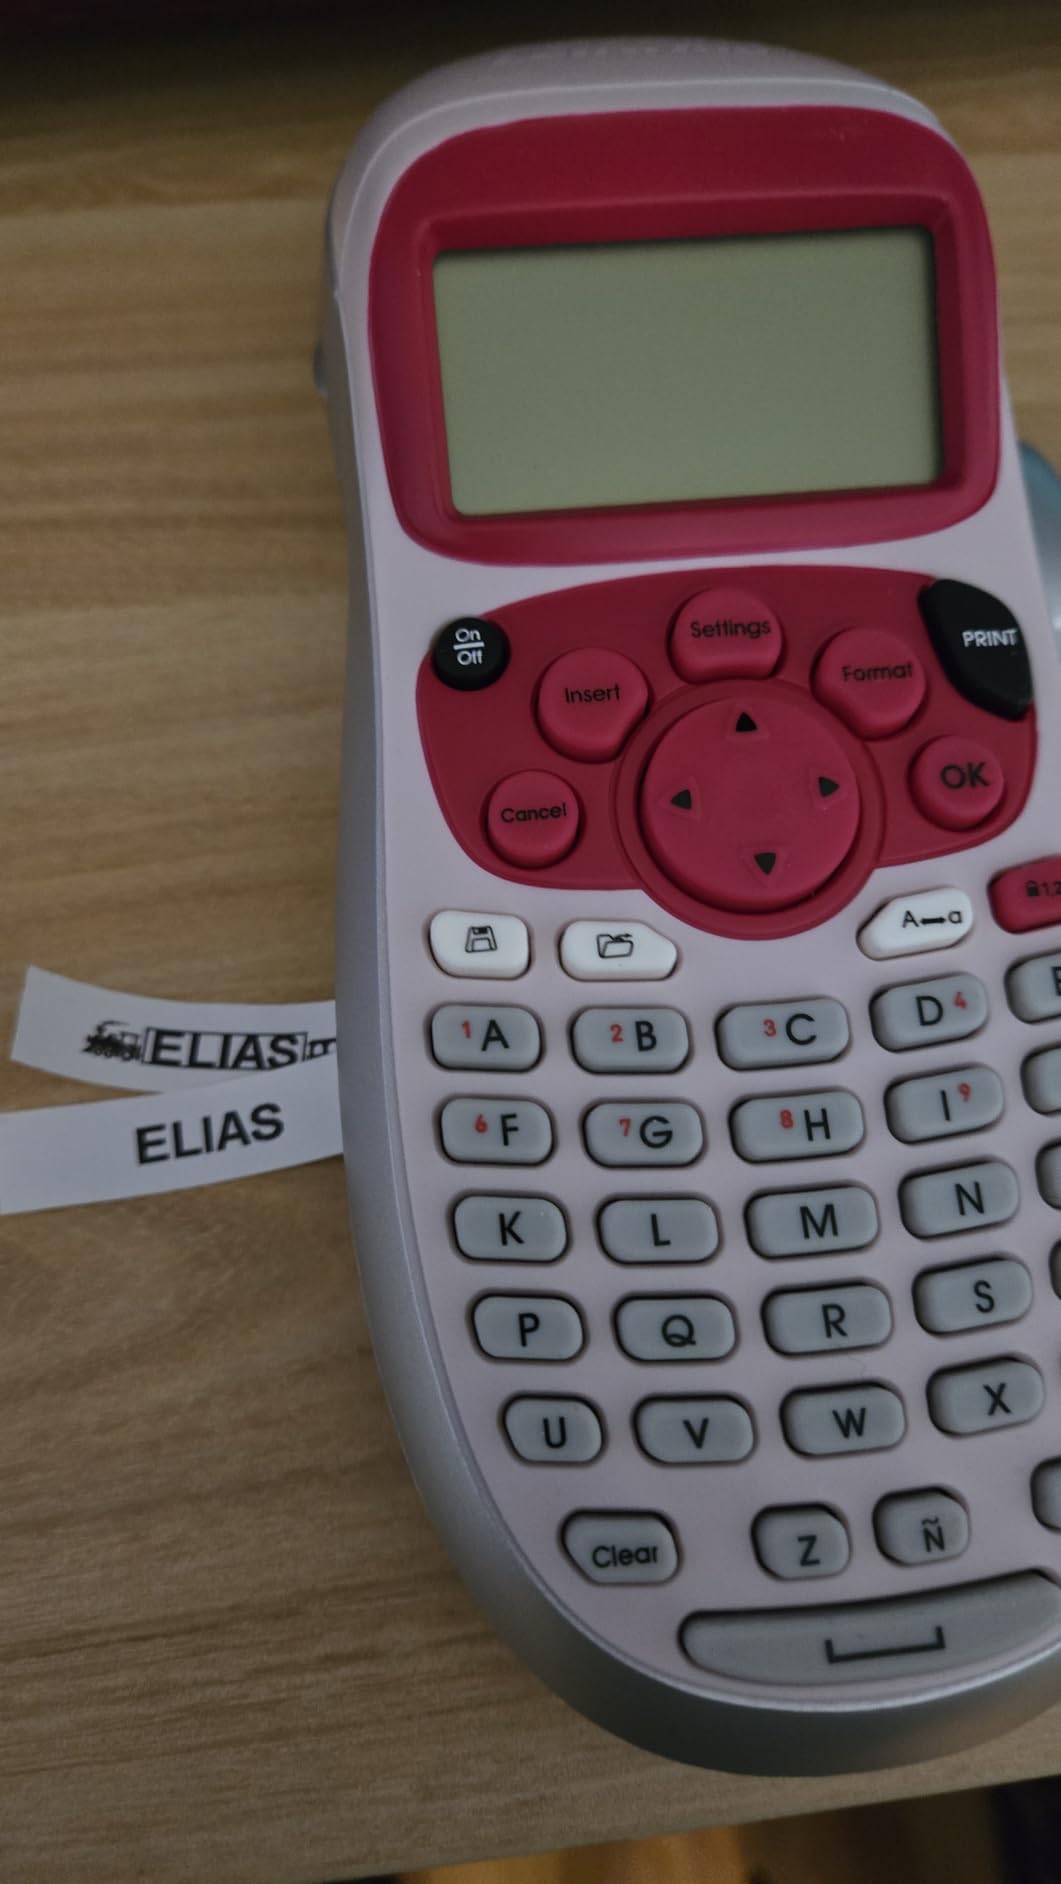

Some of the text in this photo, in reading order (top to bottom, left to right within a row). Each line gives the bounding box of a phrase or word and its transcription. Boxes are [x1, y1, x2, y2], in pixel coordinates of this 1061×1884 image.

[454, 628, 481, 643] On
[690, 618, 772, 641] Settings
[962, 628, 1018, 649] PRINT
[456, 649, 484, 666] Off
[842, 661, 913, 683] Format
[564, 683, 621, 704] Insert
[940, 761, 989, 790] OK
[500, 803, 568, 825] Cancel
[901, 910, 920, 929] A
[917, 992, 967, 1027] D 4
[461, 1019, 510, 1052] 1 A
[610, 1020, 657, 1052] 2 B
[763, 1013, 817, 1046] 3 C
[149, 1030, 299, 1069] ELIAS
[939, 1083, 972, 1122] I 9
[136, 1103, 284, 1165] ELIAS
[474, 1113, 519, 1146] 6 F
[619, 1116, 673, 1149] 7 G
[780, 1108, 831, 1141] 8 H
[954, 1181, 985, 1216] N
[500, 1211, 524, 1246] K
[651, 1213, 671, 1247] L
[800, 1204, 839, 1239] M
[974, 1280, 995, 1313] S
[518, 1313, 540, 1345] P
[661, 1314, 696, 1348] Q
[823, 1304, 846, 1339] R
[984, 1384, 1012, 1416] X
[542, 1417, 567, 1449] U
[684, 1418, 710, 1449] V
[832, 1408, 866, 1439] W
[798, 1535, 820, 1566] Z
[921, 1517, 945, 1552] Ñ
[592, 1544, 658, 1568] Clear
